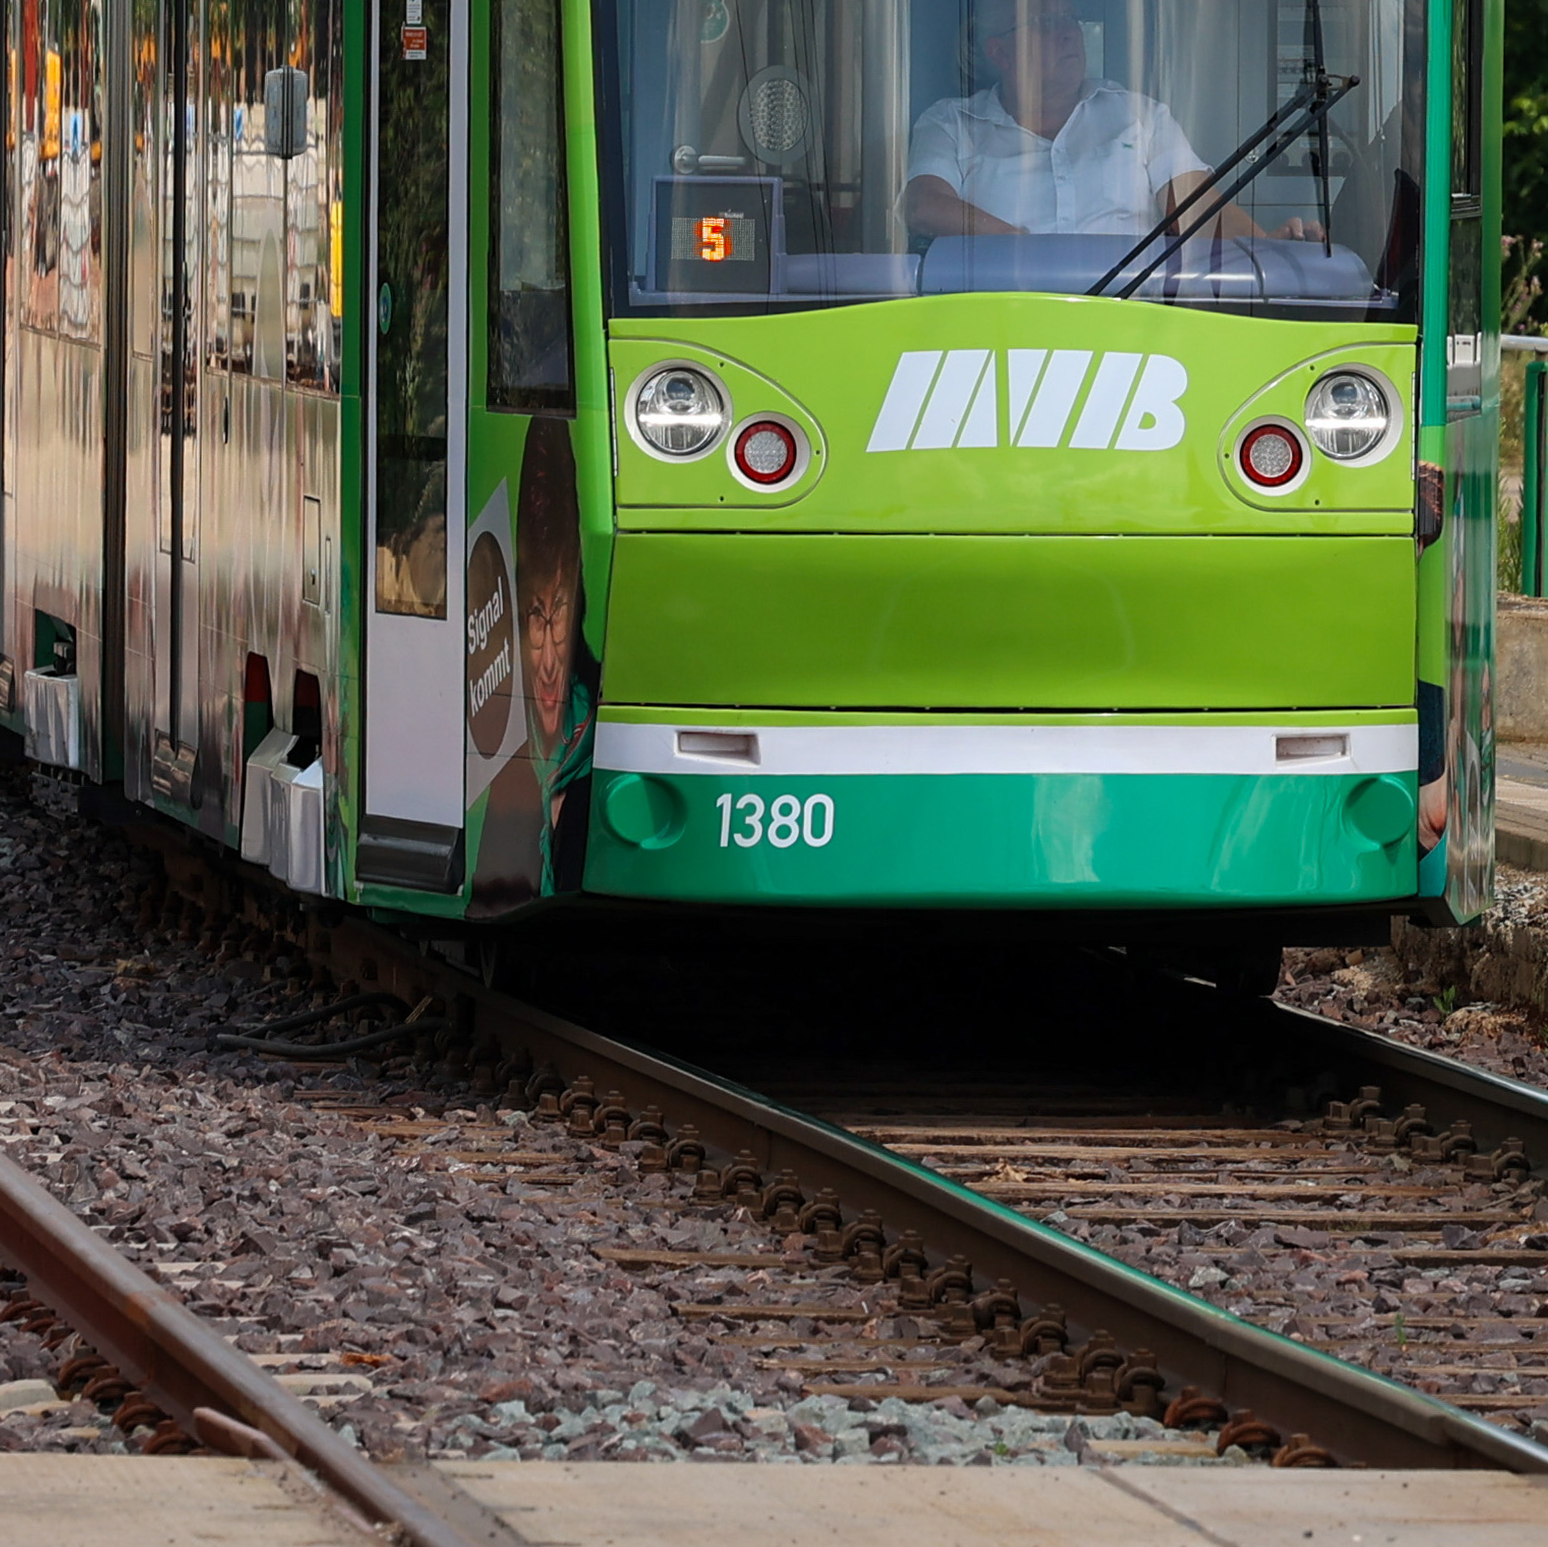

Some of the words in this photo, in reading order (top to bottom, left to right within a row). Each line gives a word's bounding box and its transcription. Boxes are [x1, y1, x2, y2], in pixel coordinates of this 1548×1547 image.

[698, 216, 730, 262] 5
[865, 348, 1189, 452] MVB
[467, 575, 504, 655] Signal
[469, 636, 511, 717] kommt
[716, 793, 835, 848] 1380
